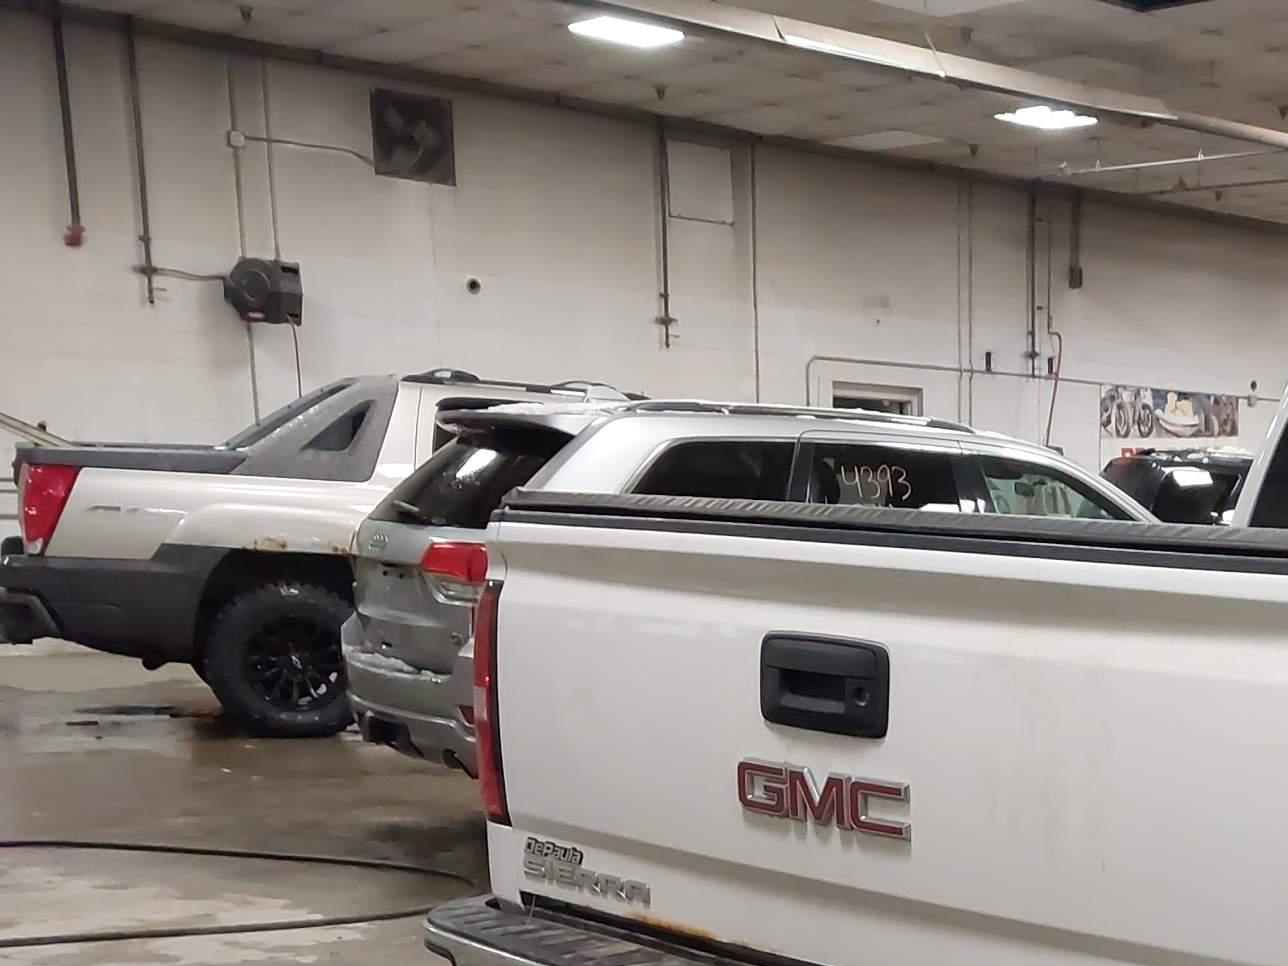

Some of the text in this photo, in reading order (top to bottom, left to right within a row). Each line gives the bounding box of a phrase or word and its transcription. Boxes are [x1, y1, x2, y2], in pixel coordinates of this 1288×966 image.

[841, 464, 912, 500] 4393
[737, 757, 912, 840] GMC
[523, 857, 652, 908] SIERRA
